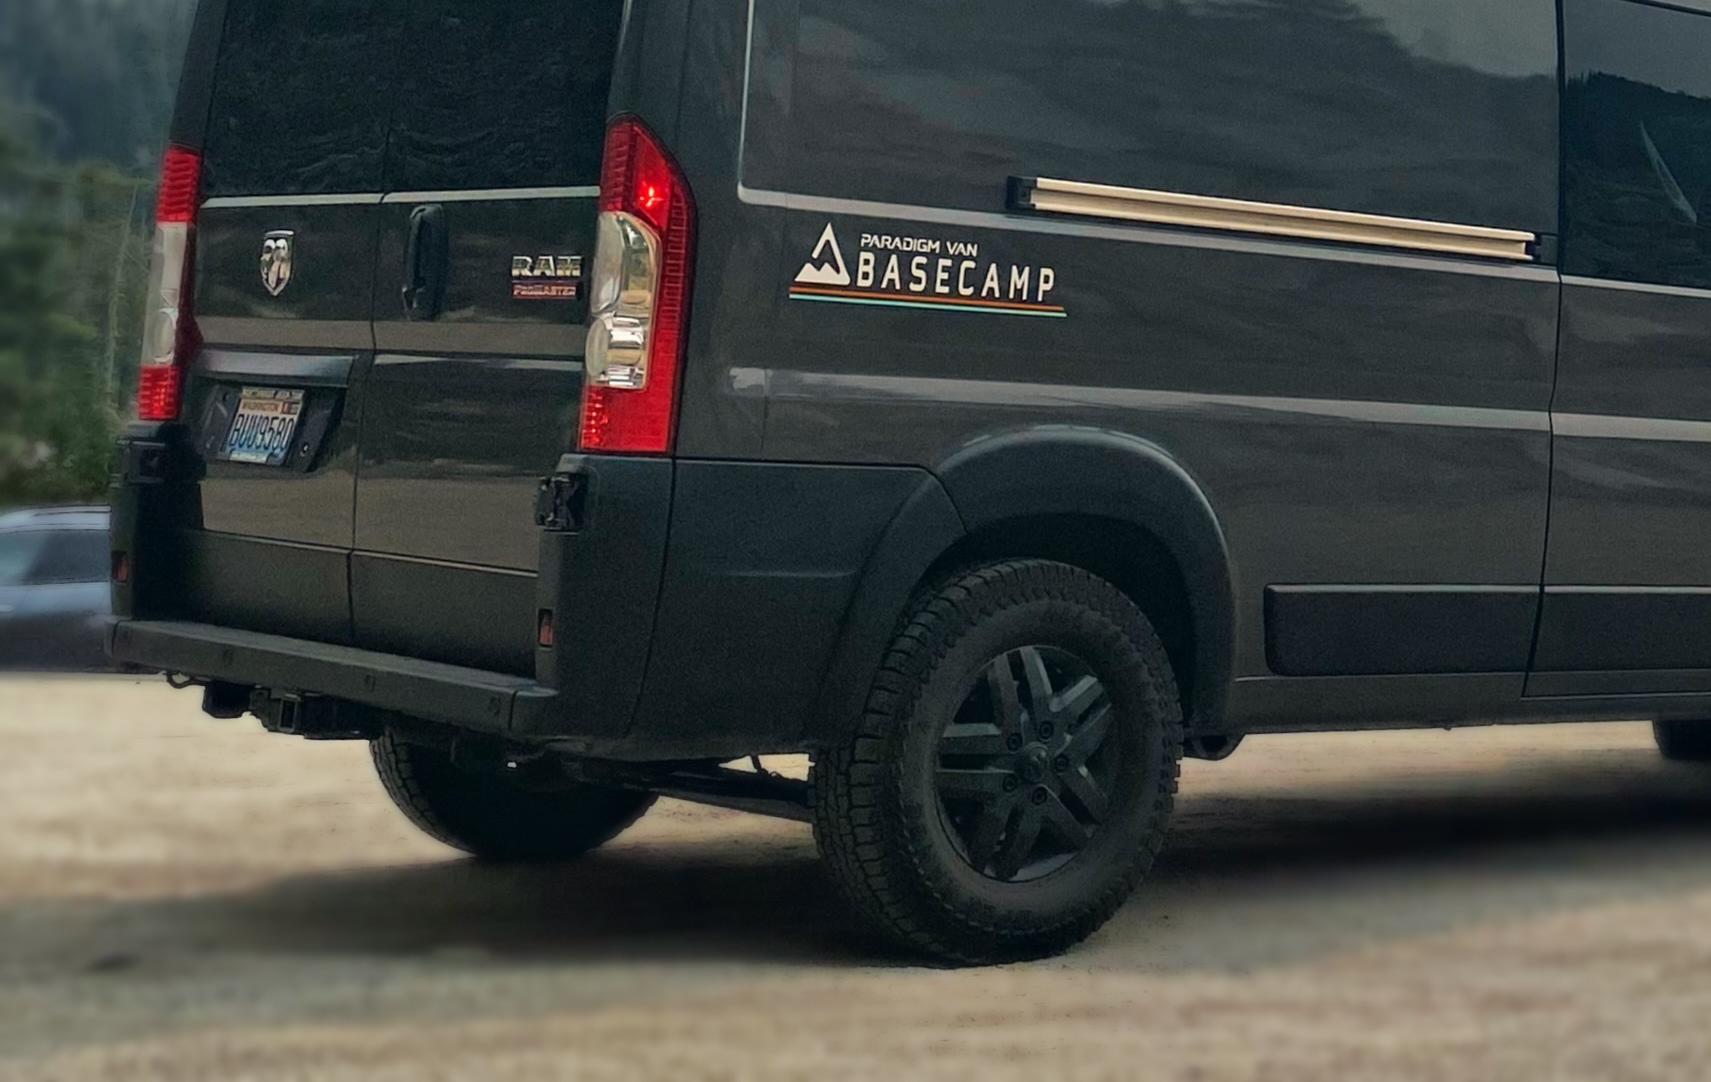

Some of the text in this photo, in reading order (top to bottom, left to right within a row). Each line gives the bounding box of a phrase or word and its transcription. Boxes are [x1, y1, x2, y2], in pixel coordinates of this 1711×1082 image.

[861, 234, 978, 257] PARADIGM VAN
[511, 255, 582, 277] RAM
[856, 251, 1055, 302] BASECAMP
